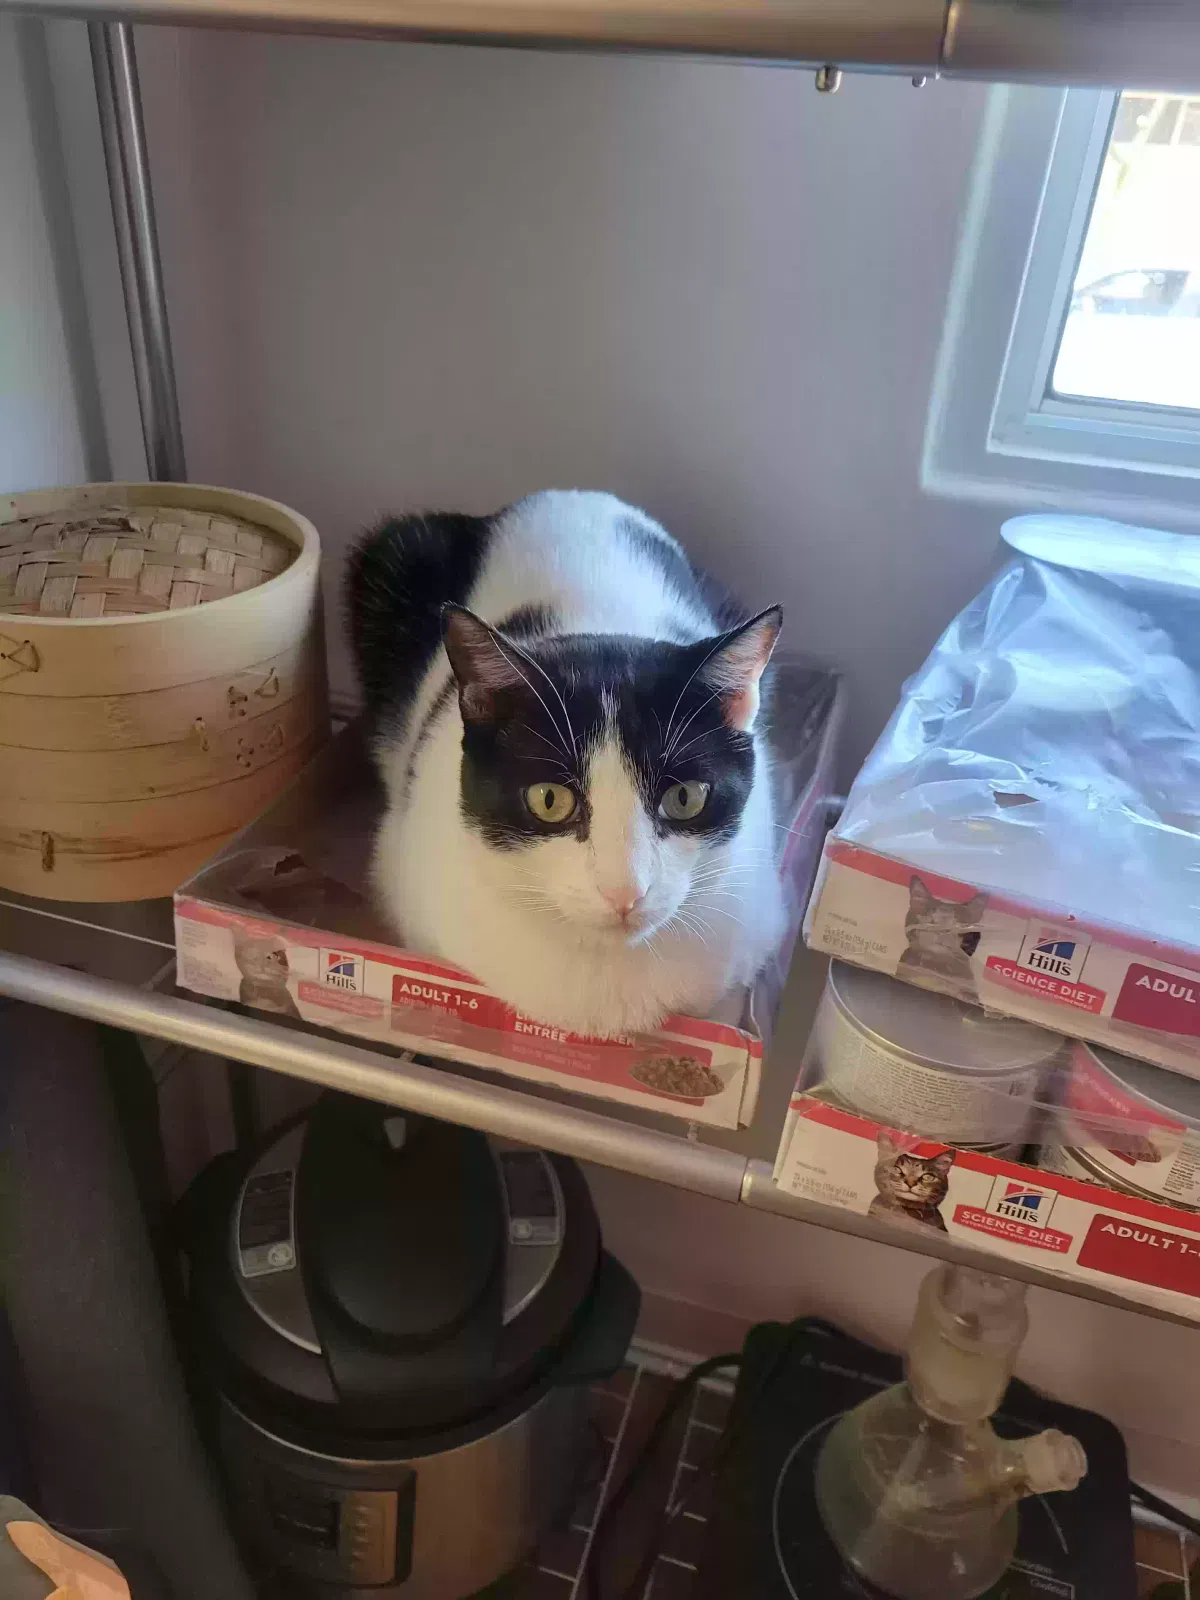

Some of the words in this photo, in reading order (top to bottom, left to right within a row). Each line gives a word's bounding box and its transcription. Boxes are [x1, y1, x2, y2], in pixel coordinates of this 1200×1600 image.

[1027, 952, 1072, 977] Hill's
[326, 974, 357, 991] Hill's
[400, 982, 452, 1004] ADULT
[455, 994, 479, 1010] 1-6
[993, 964, 1057, 992] SCIENCE
[1060, 985, 1097, 1005] DIET
[1135, 975, 1200, 1003] ADUL
[514, 1021, 567, 1042] ENTRÉE
[996, 1202, 1039, 1223] Hill's
[962, 1210, 1026, 1234] SCIENCE
[1028, 1229, 1065, 1246] DIET
[1101, 1223, 1175, 1249] ADULT
[1180, 1243, 1200, 1257] 1-
